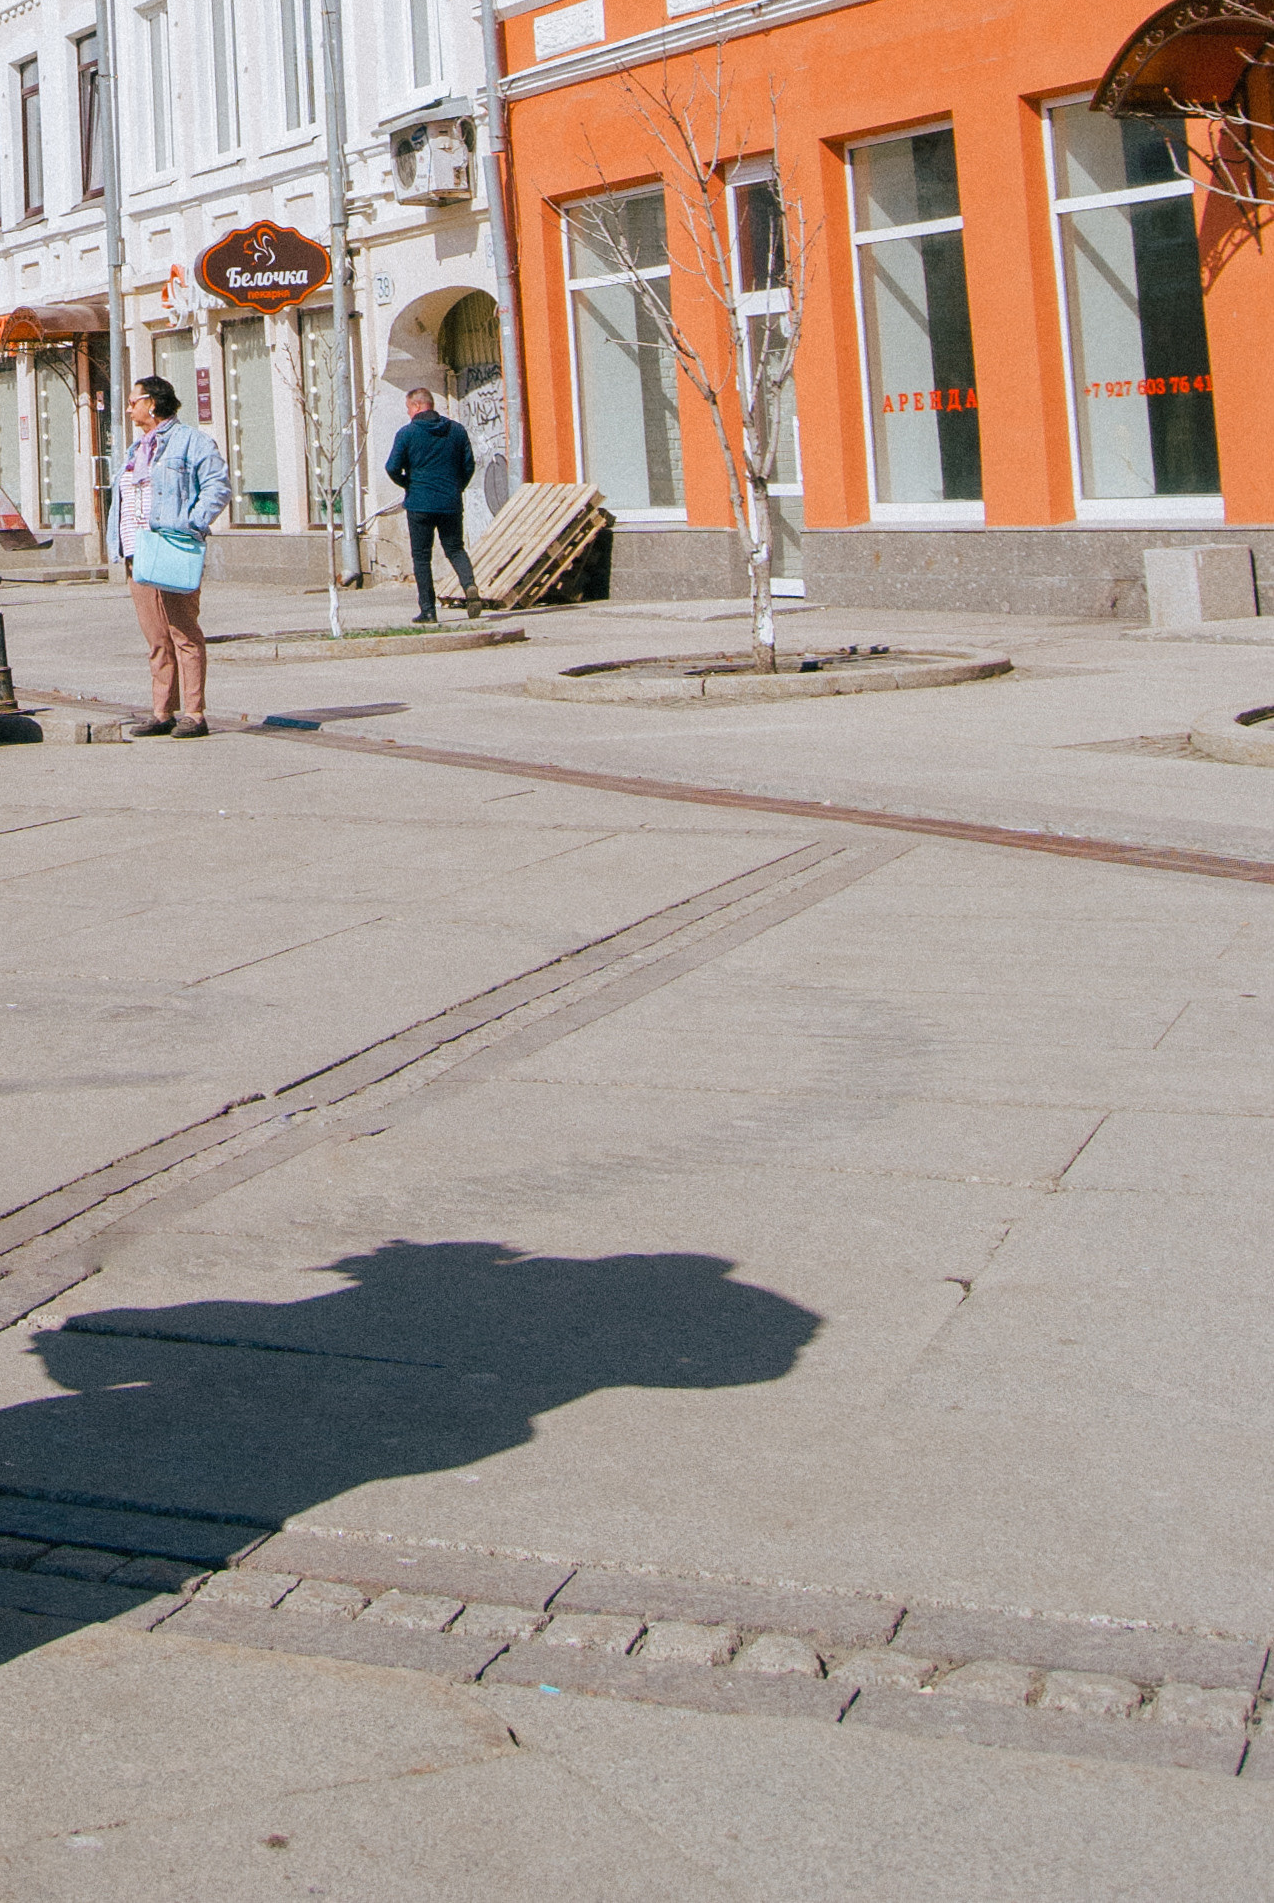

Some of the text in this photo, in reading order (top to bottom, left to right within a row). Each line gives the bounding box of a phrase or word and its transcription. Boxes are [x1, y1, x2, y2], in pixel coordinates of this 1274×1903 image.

[226, 267, 308, 288] Белочка
[377, 277, 390, 298] 38
[247, 289, 291, 300] пекарня
[1084, 375, 1213, 398] +7 927 603 76 41
[882, 388, 979, 413] АРЕНДА
